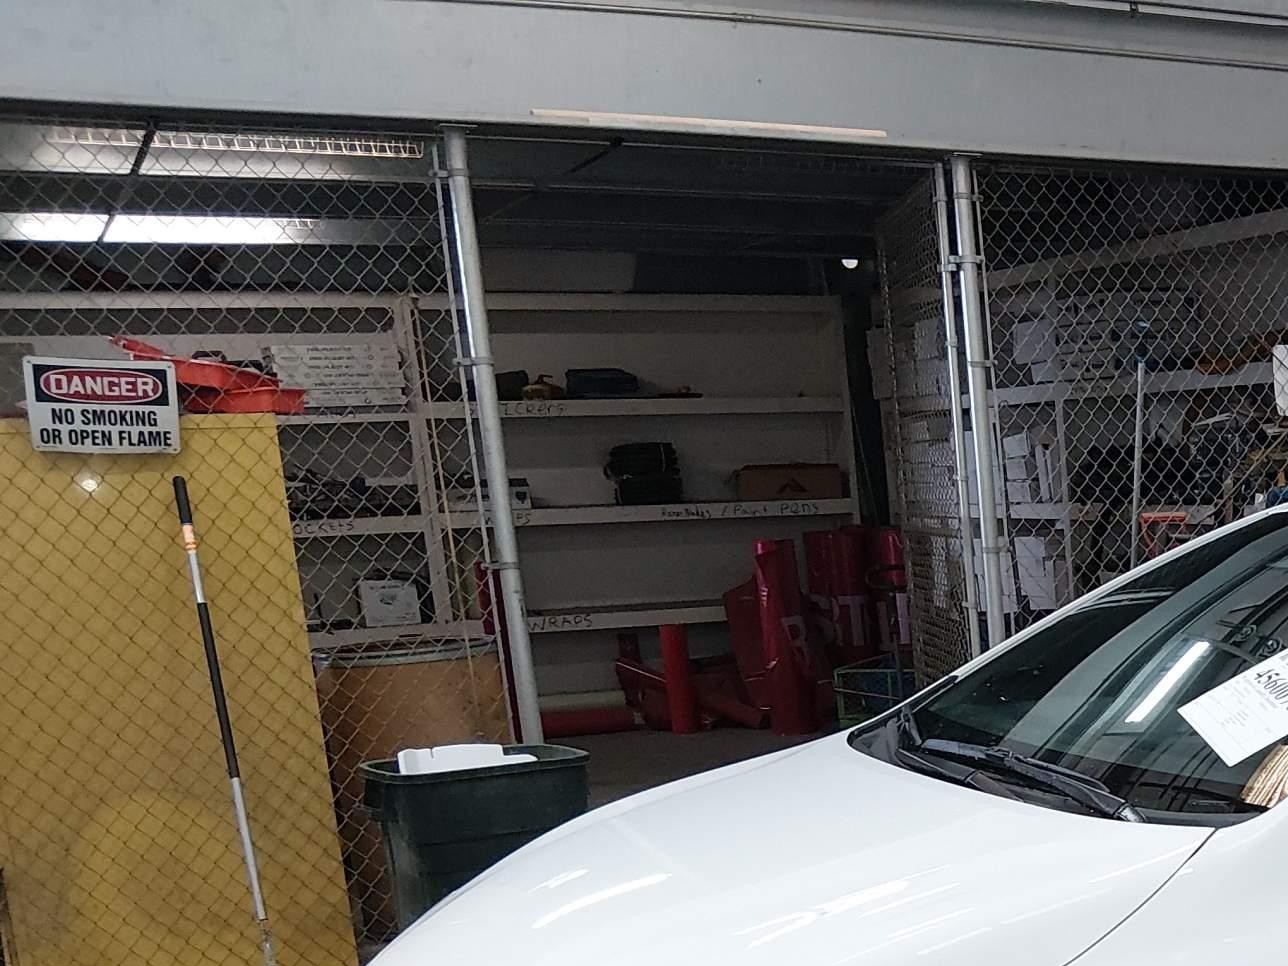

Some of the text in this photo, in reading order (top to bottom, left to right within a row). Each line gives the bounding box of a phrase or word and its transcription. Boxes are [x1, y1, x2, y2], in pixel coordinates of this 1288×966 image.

[50, 374, 154, 397] DANGER
[51, 408, 158, 427] NO SMOKING
[40, 428, 173, 447] OR OPEN FLAME
